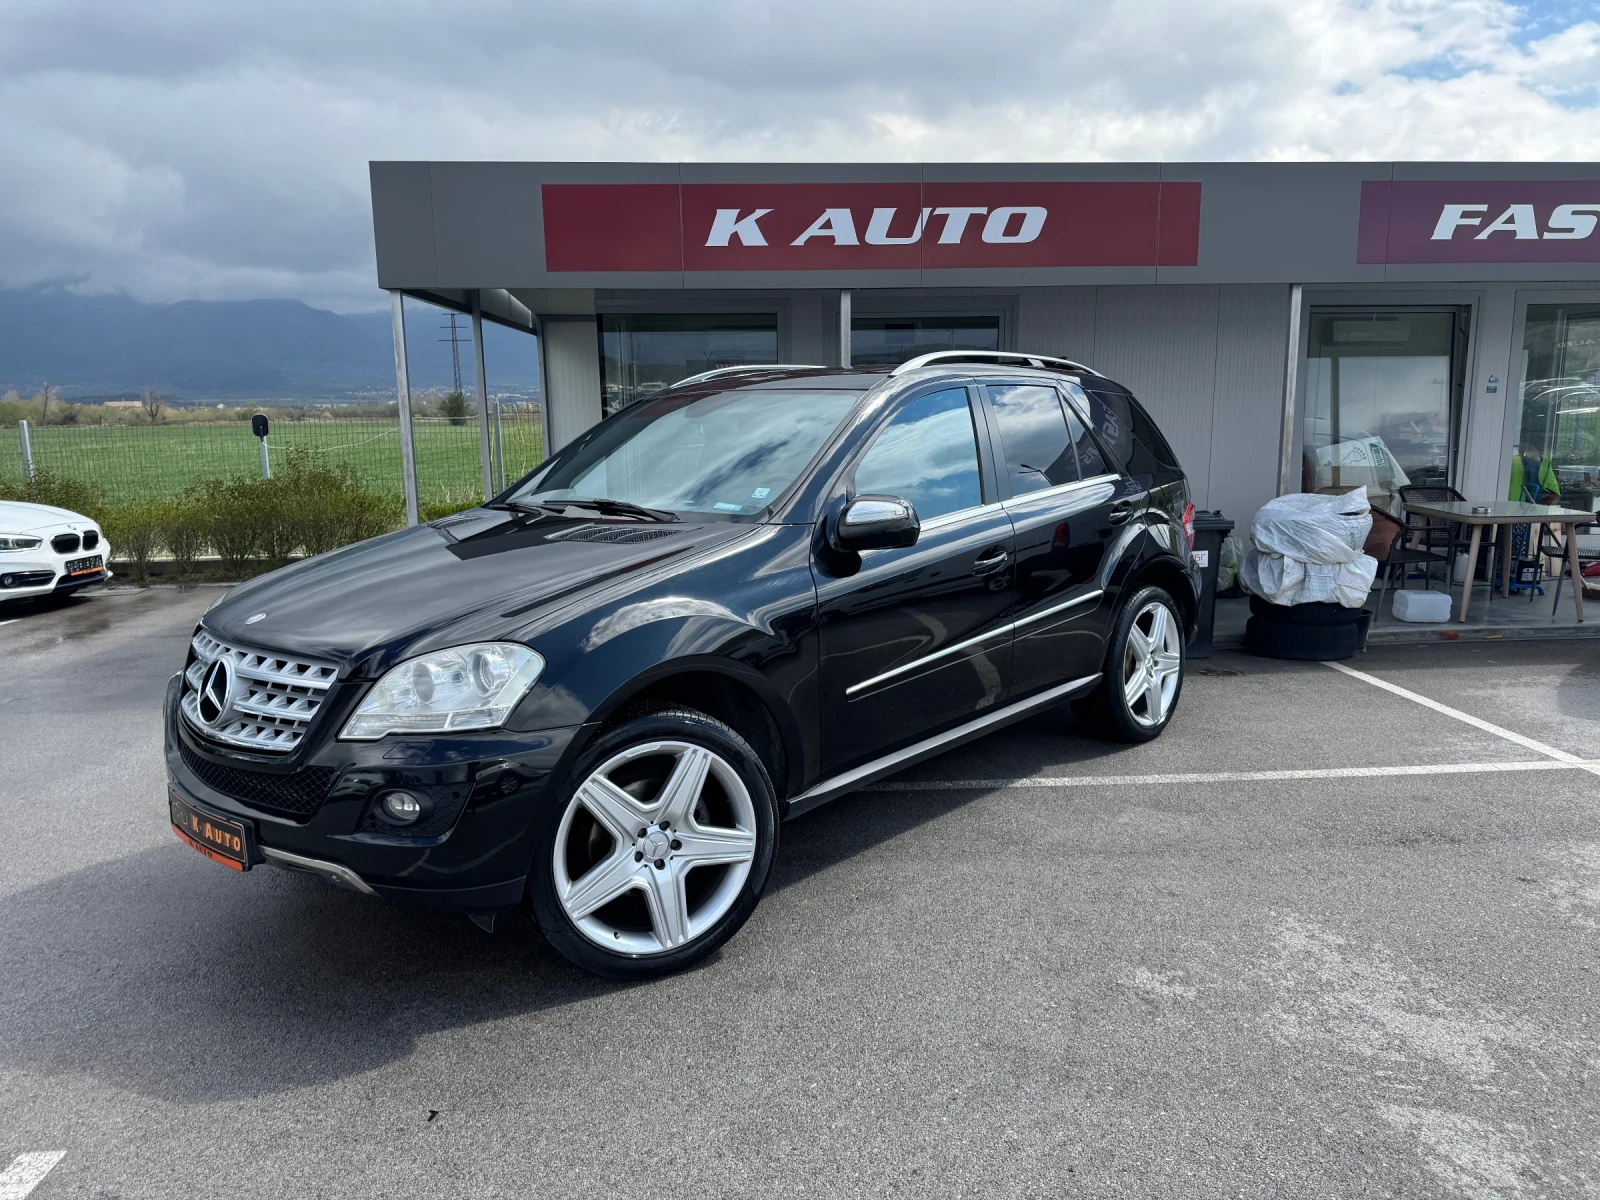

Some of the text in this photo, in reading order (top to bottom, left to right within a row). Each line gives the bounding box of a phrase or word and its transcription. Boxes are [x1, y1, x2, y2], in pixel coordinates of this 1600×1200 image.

[704, 206, 1048, 246] K AUTO
[205, 822, 241, 852] AUTO
